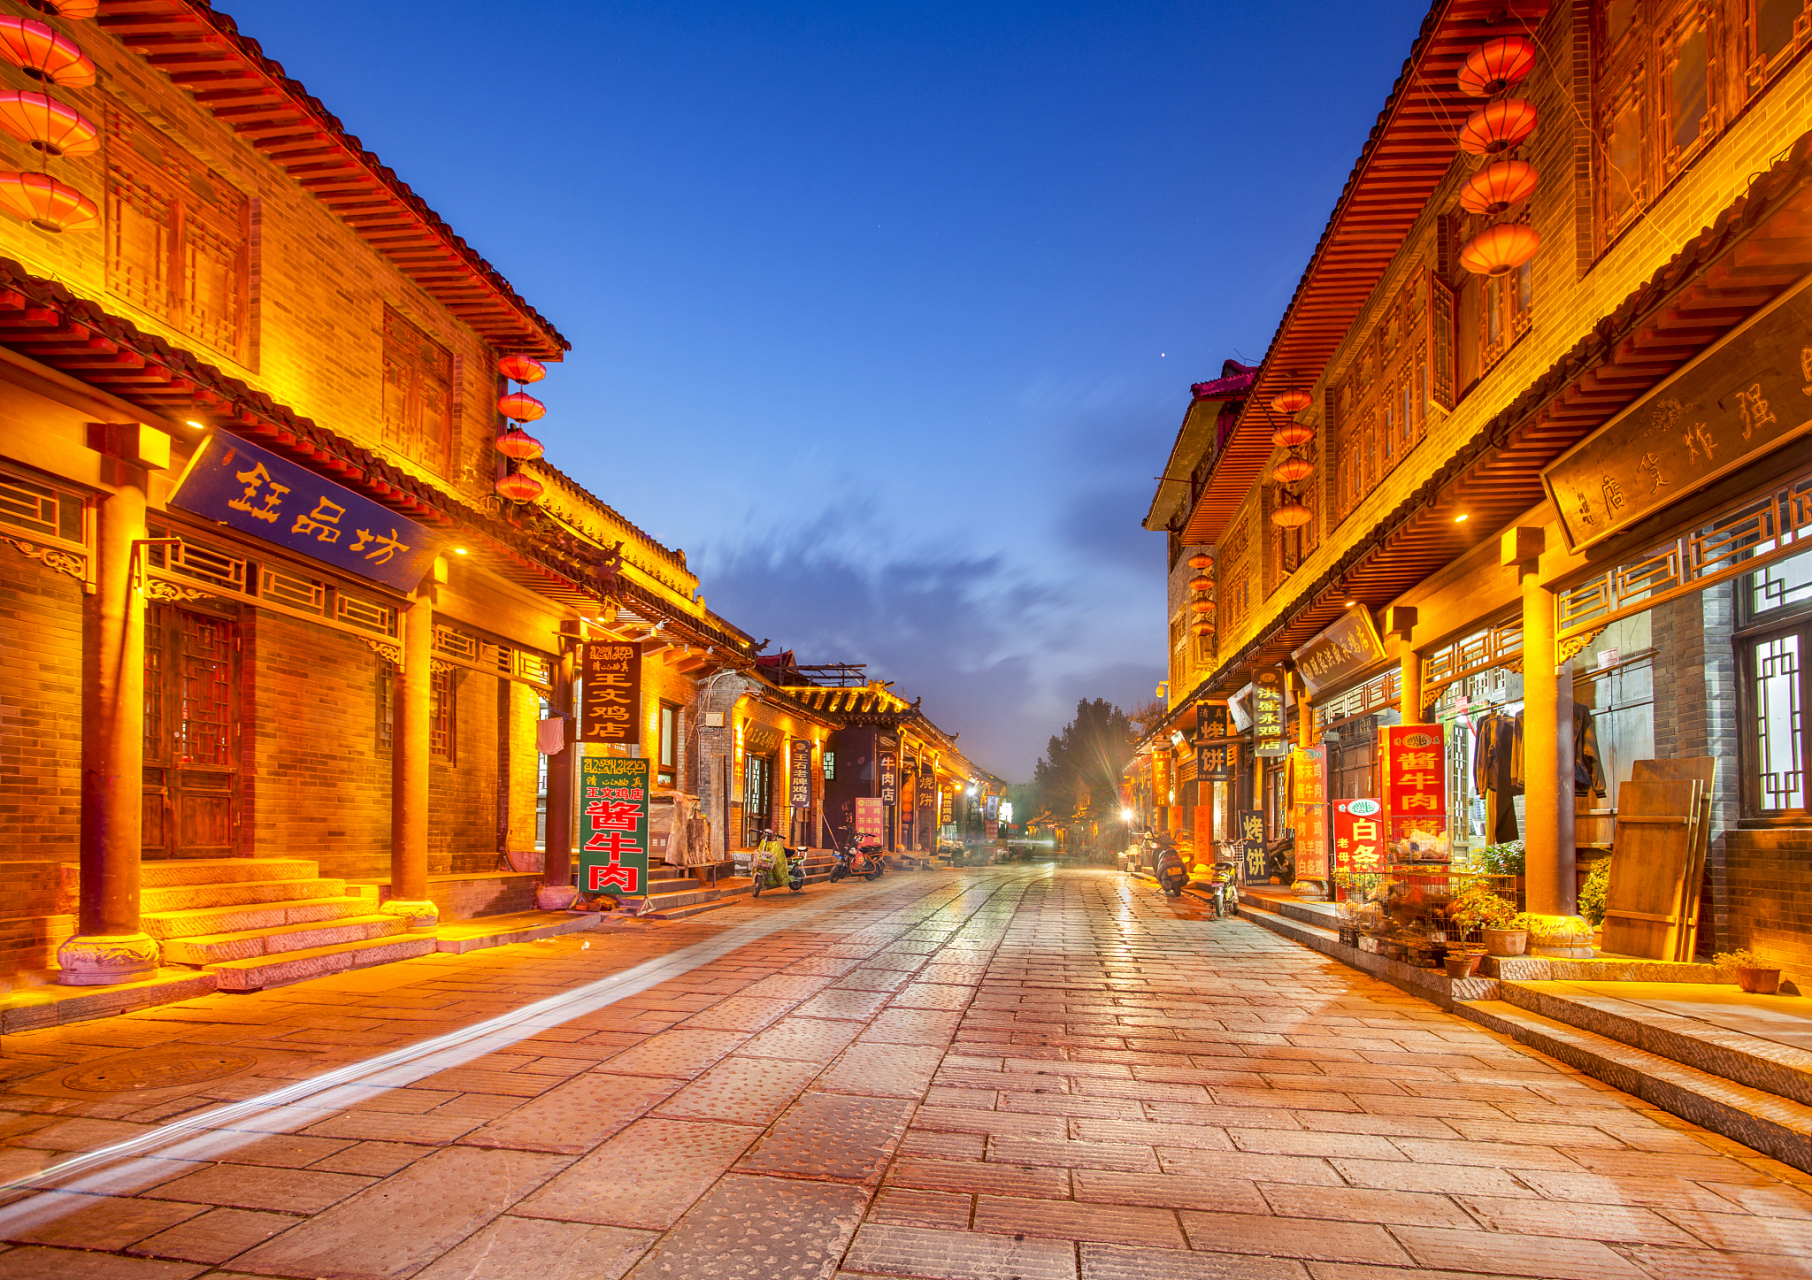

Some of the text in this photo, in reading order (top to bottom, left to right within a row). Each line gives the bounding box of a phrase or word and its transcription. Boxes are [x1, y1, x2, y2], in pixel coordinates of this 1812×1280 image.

[1601, 345, 1812, 520] 强炸货店
[586, 673, 633, 738] 王文鸡店
[1257, 687, 1281, 750] 洪盛永鸡店
[1200, 721, 1225, 772] 烤饼
[1297, 763, 1322, 780] 芥末鸡
[586, 787, 644, 801] 王文鸡店
[792, 753, 808, 802] 王石老牌鸡店
[880, 756, 896, 802] 牛肉店
[919, 776, 934, 807] 烧饼
[1297, 782, 1322, 799] 酱牛肉
[1397, 752, 1441, 811] 酱牛肉
[584, 800, 645, 893] 酱牛肉
[1243, 815, 1266, 876] 烤饼
[1298, 859, 1325, 875] 白条鸡
